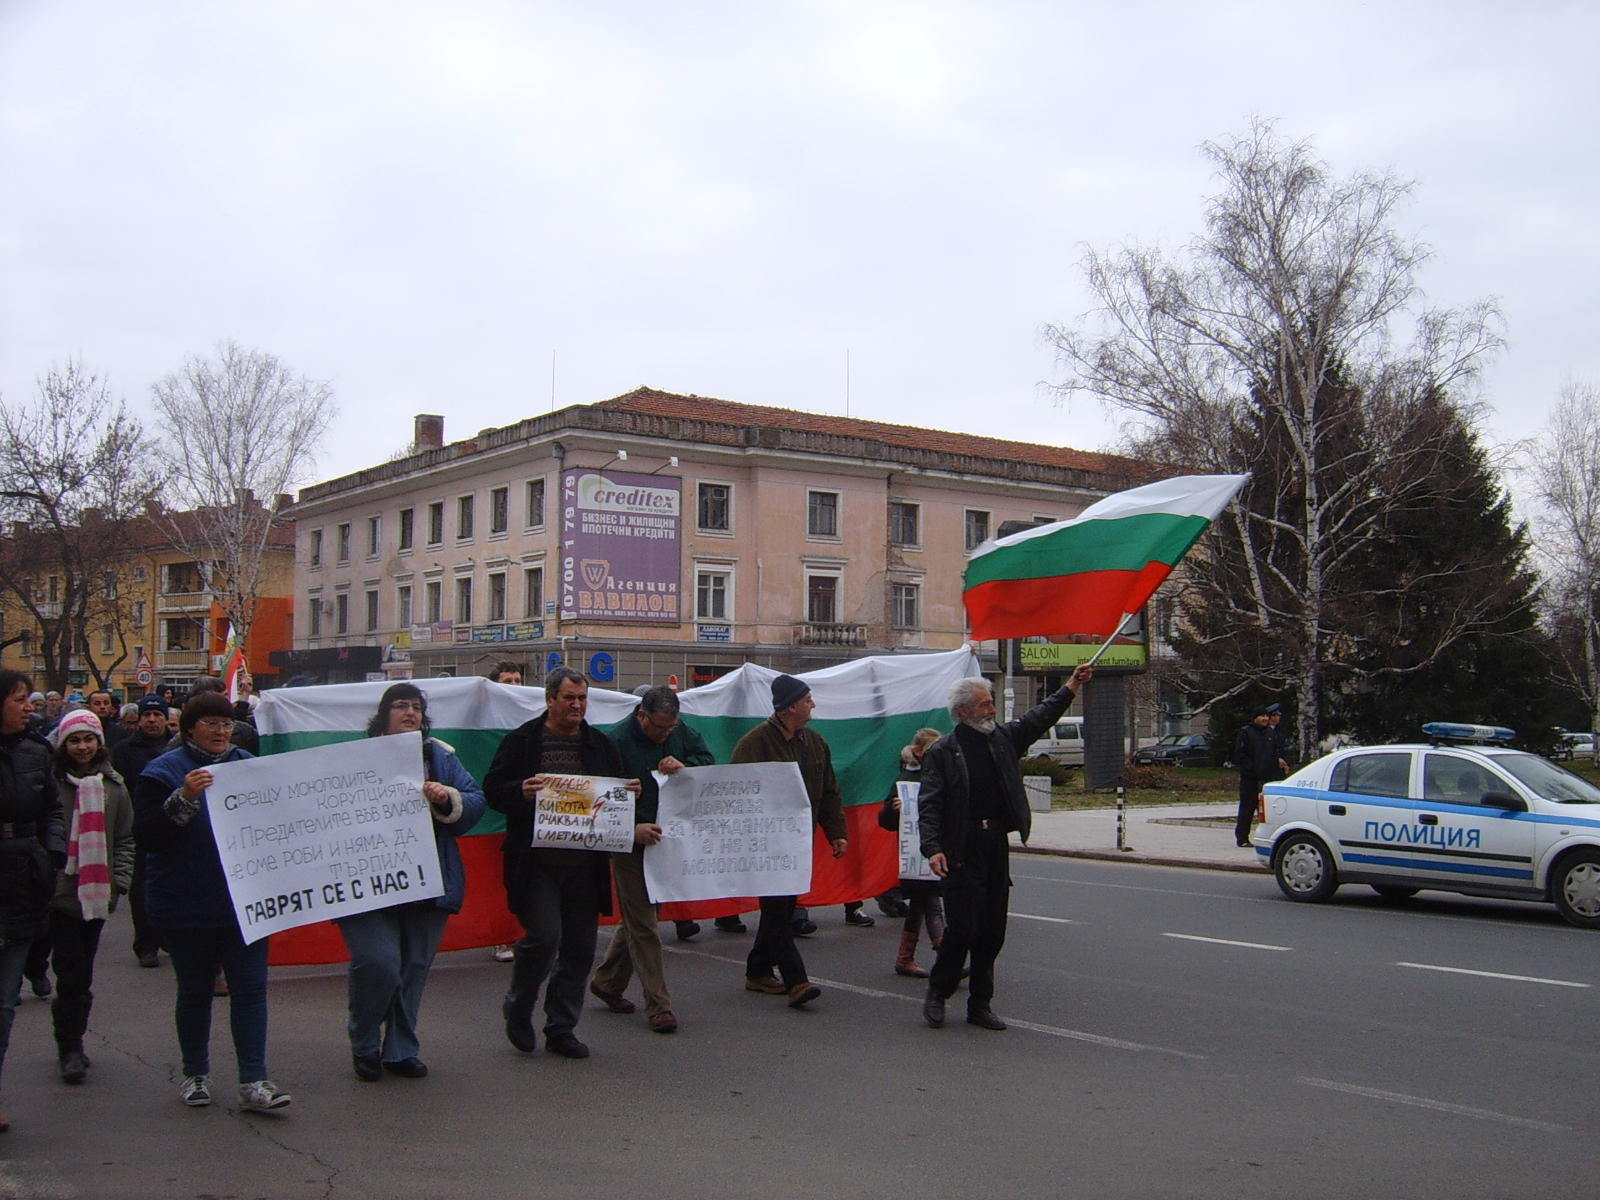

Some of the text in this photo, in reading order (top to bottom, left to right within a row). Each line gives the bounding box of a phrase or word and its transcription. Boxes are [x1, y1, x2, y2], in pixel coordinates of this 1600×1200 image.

[565, 475, 575, 500] 79
[593, 489, 675, 509] creditex
[564, 506, 575, 532] 79
[582, 512, 675, 529] БИЗНЕС И ЖИЛИЩНИ
[582, 523, 675, 540] ИПОТЕЧНИ КРЕДИТИ
[563, 557, 575, 607] 0700
[606, 576, 677, 592] Агенция
[579, 591, 677, 612] ВАВИЛОН
[140, 673, 150, 682] 40
[590, 652, 614, 681] G
[393, 827, 419, 850] ДА
[1364, 820, 1481, 850] ПОЛИЦИЯ
[245, 889, 314, 926] ГАВРЯТ
[322, 882, 346, 905] СЕ
[351, 879, 364, 900] С
[370, 870, 409, 896] НАС
